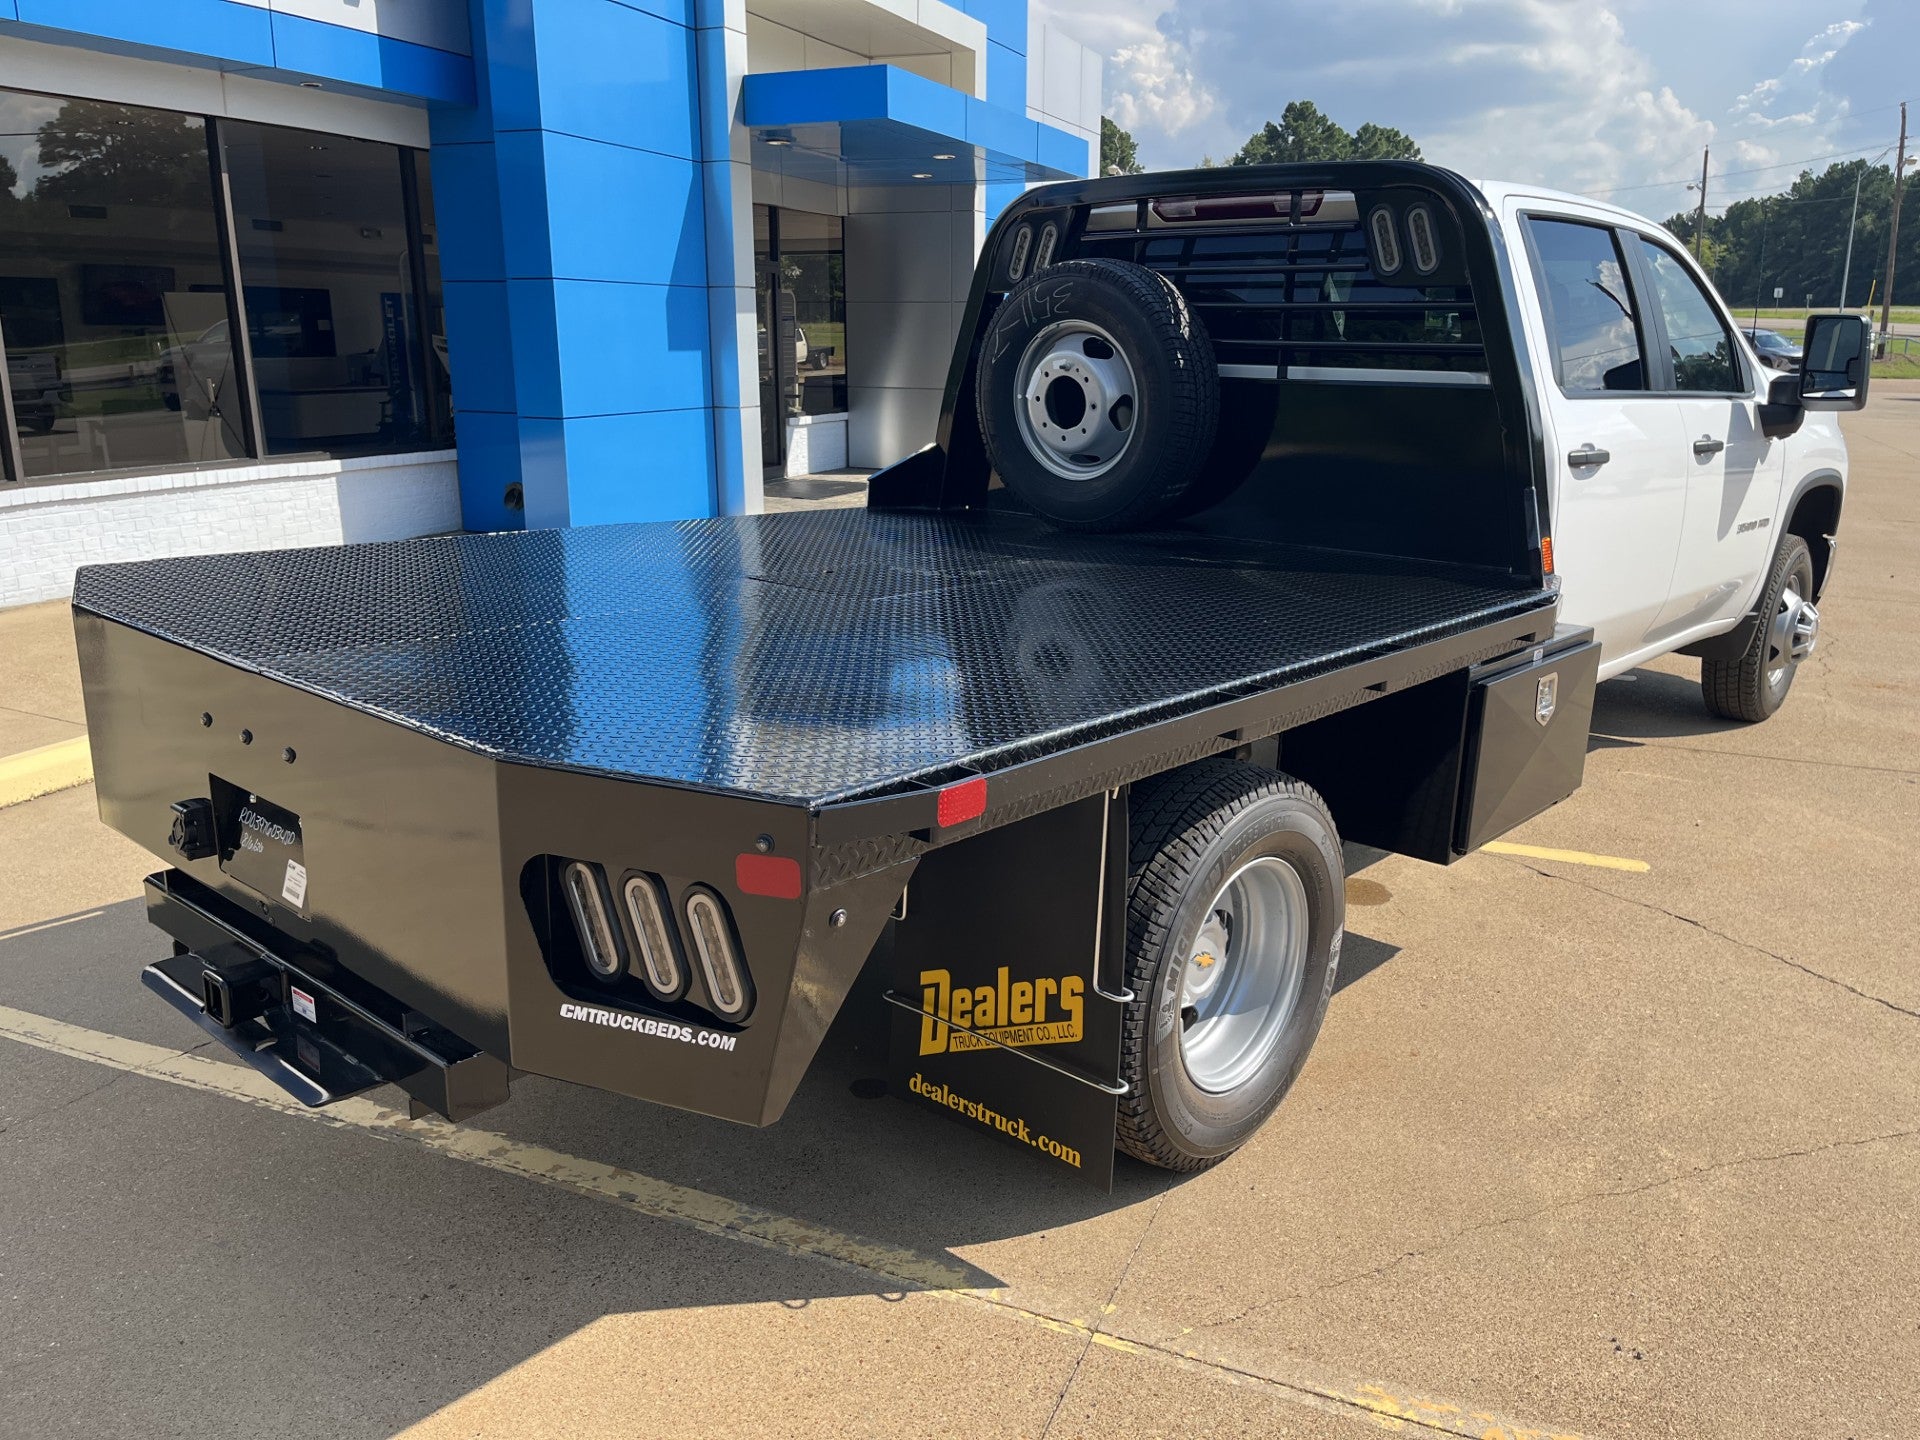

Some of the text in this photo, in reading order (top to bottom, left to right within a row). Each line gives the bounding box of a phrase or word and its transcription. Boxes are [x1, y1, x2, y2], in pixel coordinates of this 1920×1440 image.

[560, 1003, 737, 1052] CMTRUCKBEDS.COM
[919, 966, 1085, 1057] Dealers
[953, 1034, 984, 1050] TRUCK
[984, 1028, 1035, 1049] EQUIPMENT
[908, 1072, 1082, 1169] dealerstruck.com
